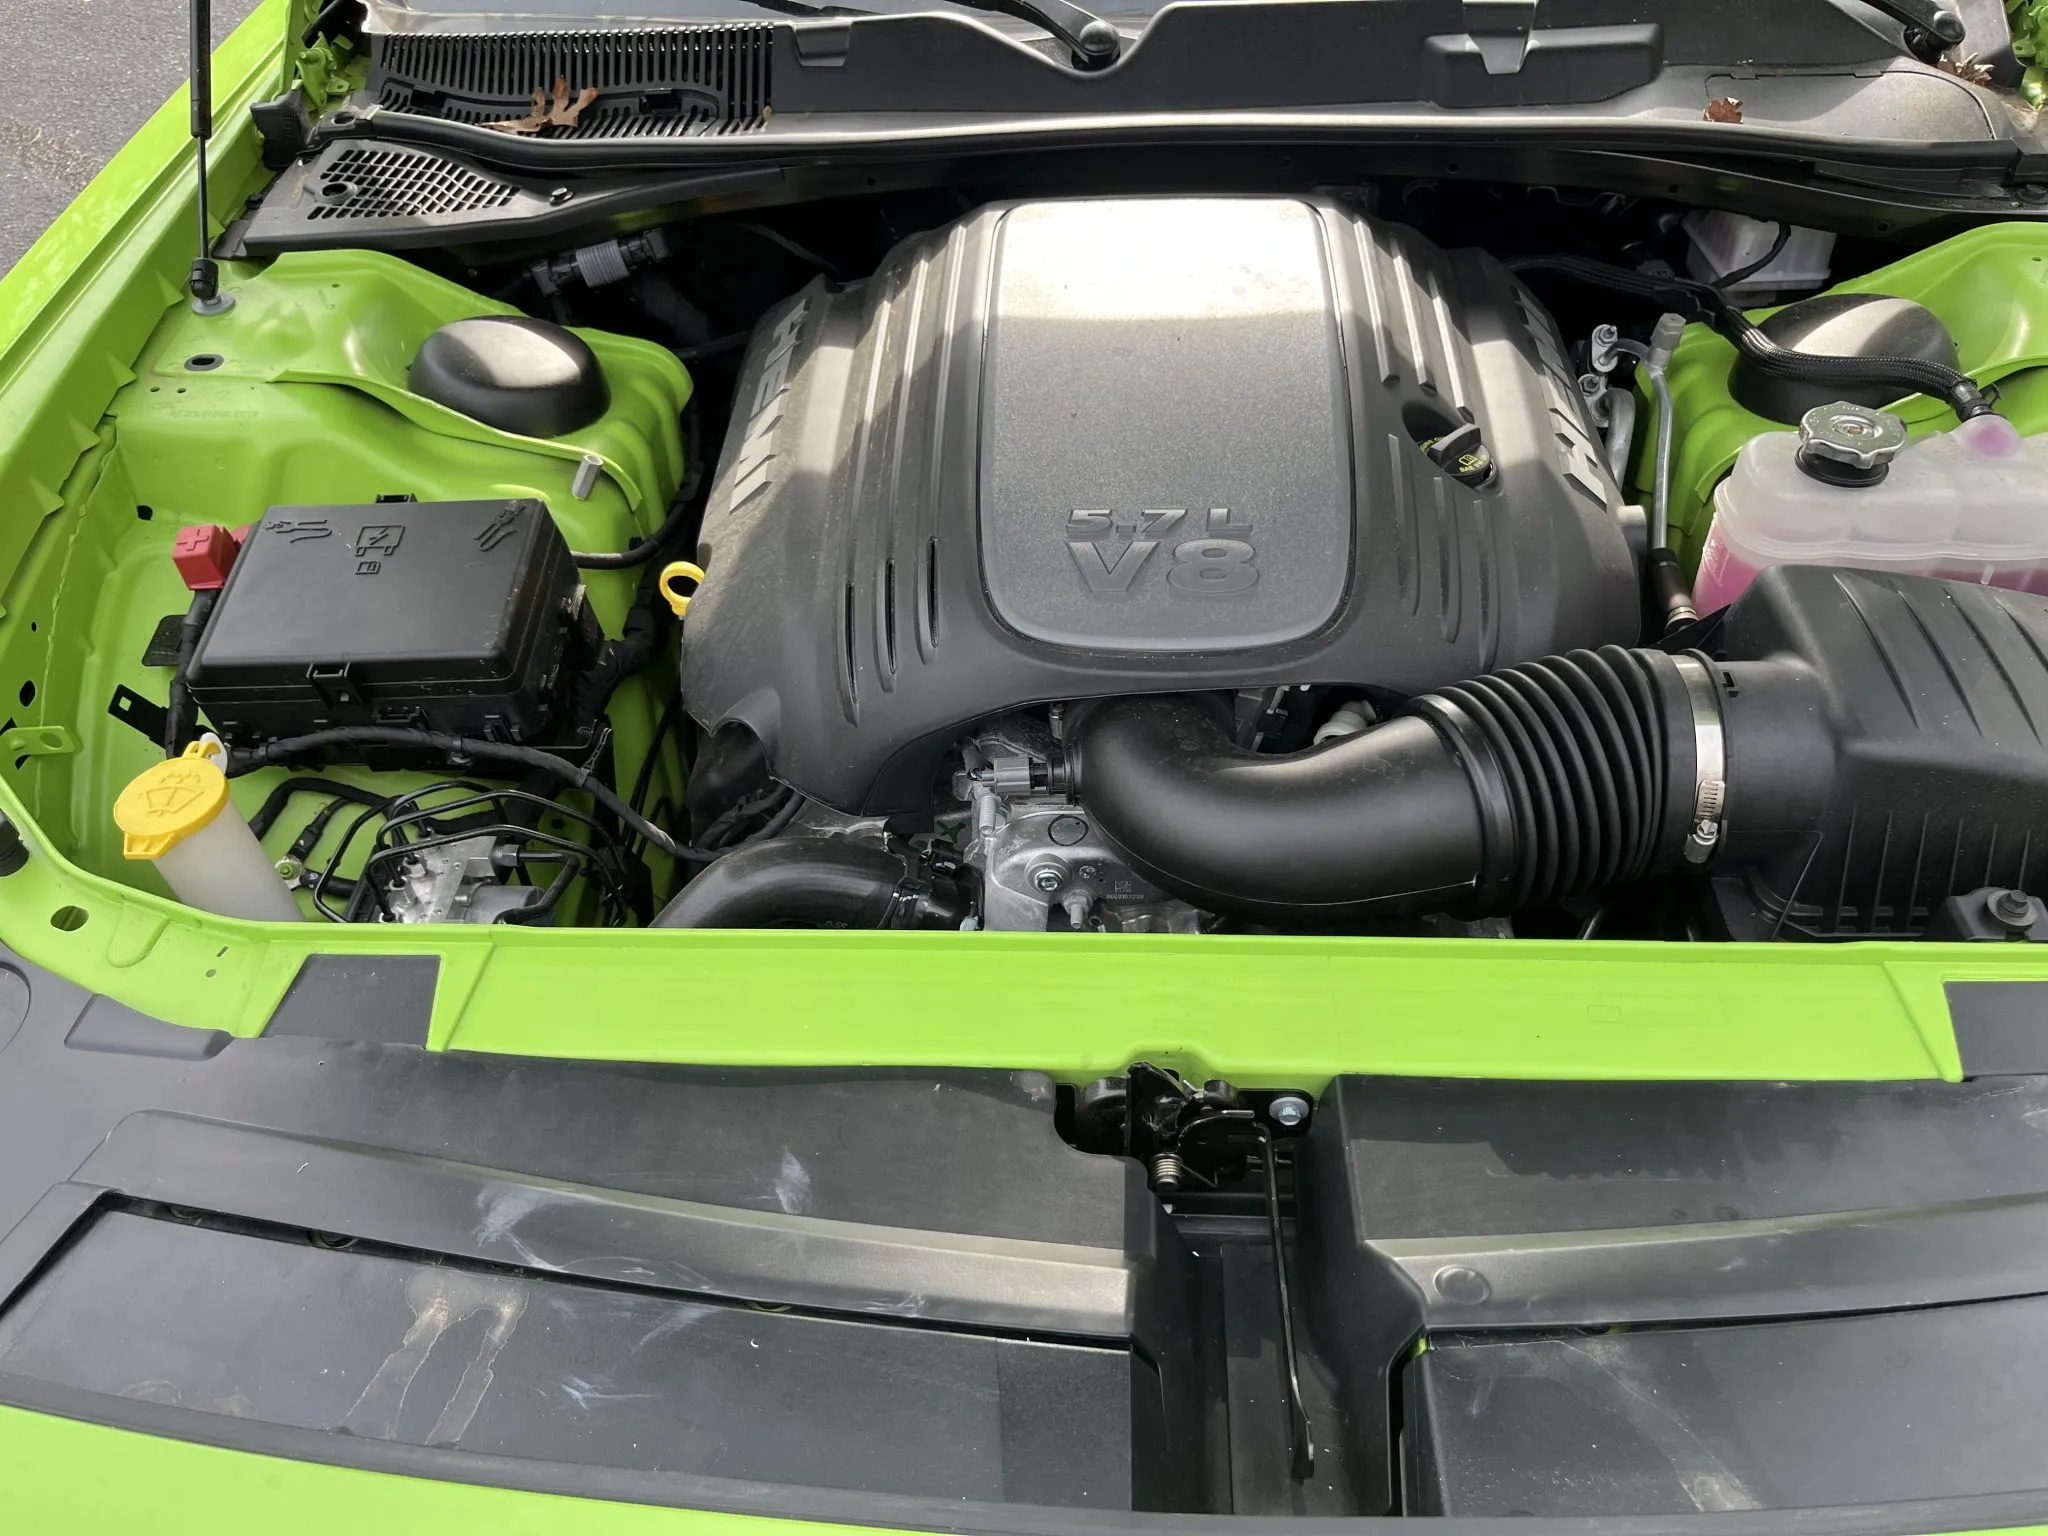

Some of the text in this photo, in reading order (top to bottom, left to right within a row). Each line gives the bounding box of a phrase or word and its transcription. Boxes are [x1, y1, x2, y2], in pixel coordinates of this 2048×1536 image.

[729, 298, 809, 515] HEMI
[1515, 287, 1608, 512] HEMI
[1065, 539, 1260, 594] V8
